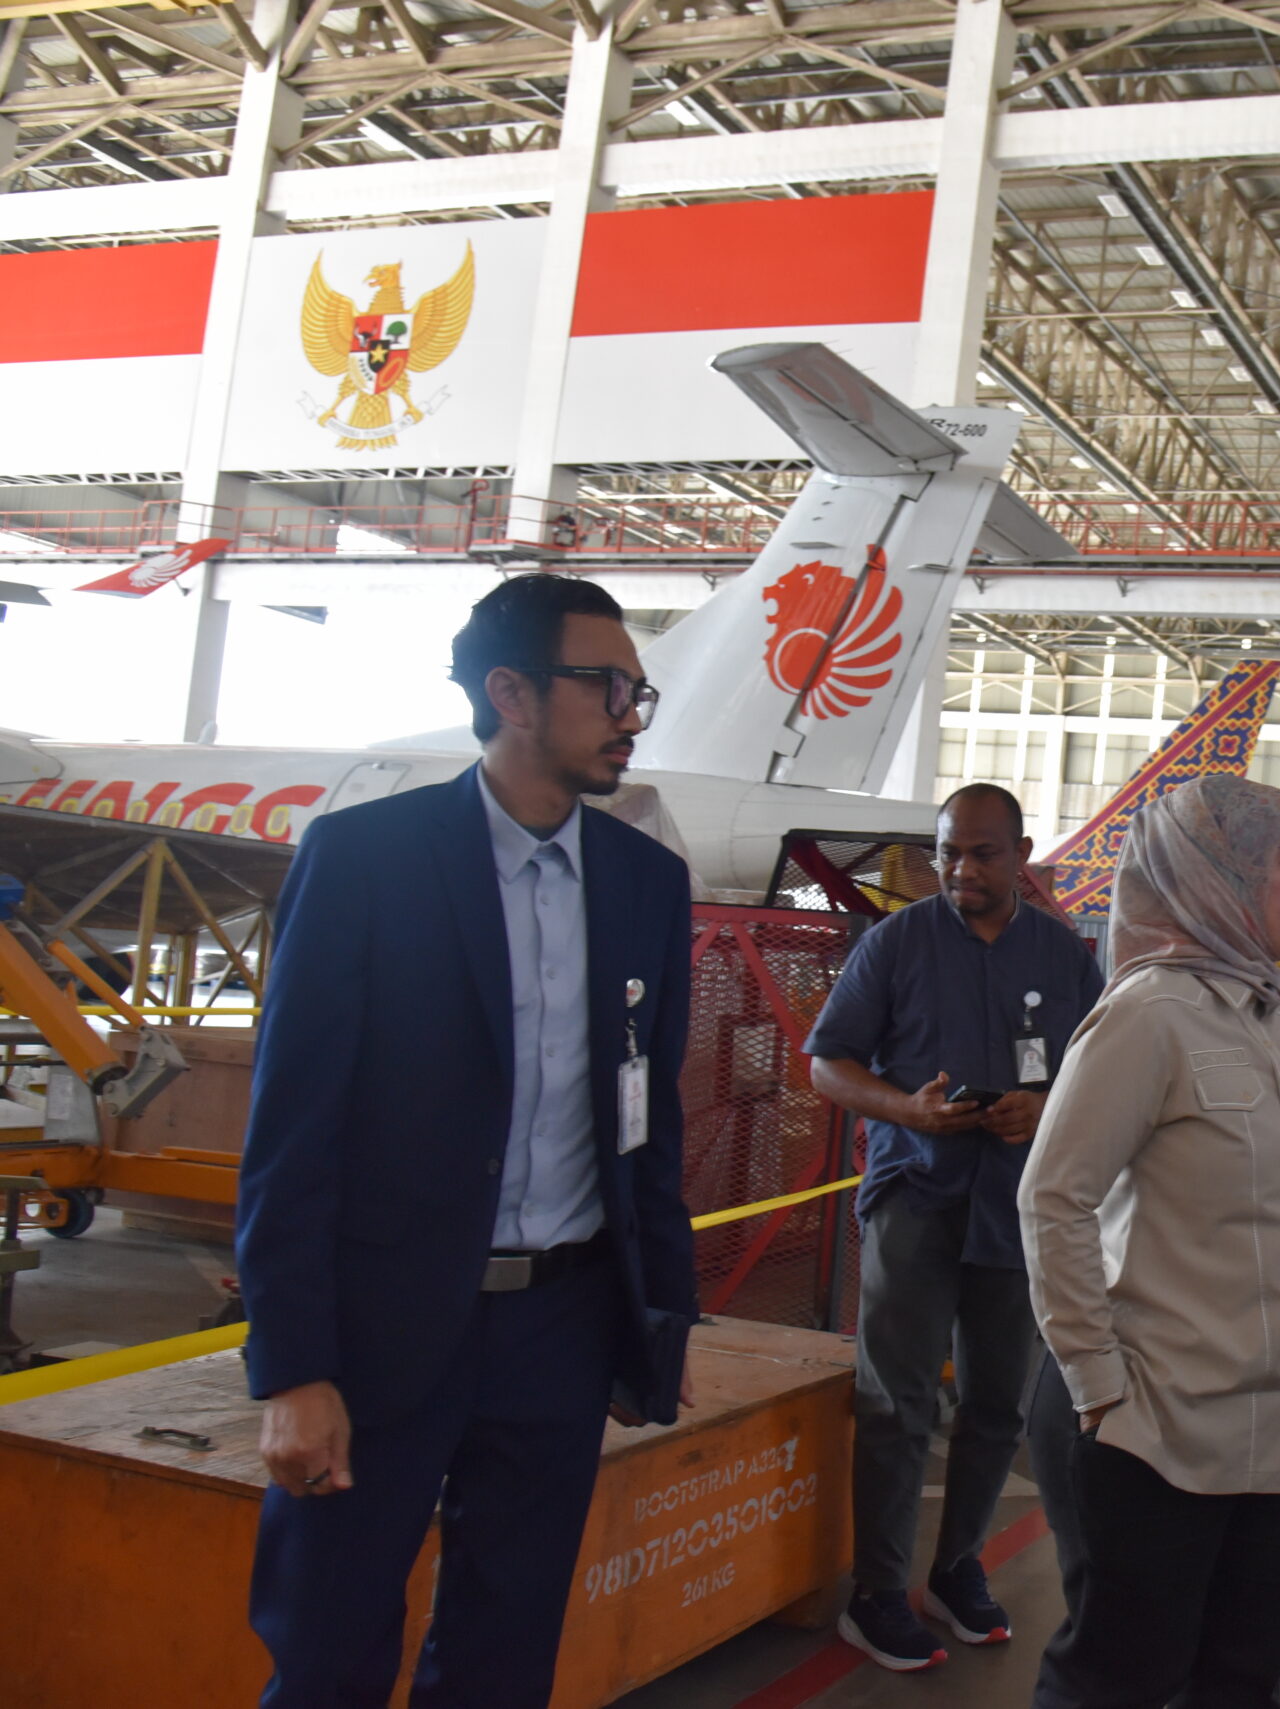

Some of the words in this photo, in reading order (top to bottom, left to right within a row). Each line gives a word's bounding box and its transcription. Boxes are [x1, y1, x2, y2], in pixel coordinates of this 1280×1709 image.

[944, 423, 987, 437] 72-600
[633, 1459, 744, 1524] BOOTSTRAP
[681, 1576, 709, 1607] 261
[711, 1562, 736, 1593] KG
